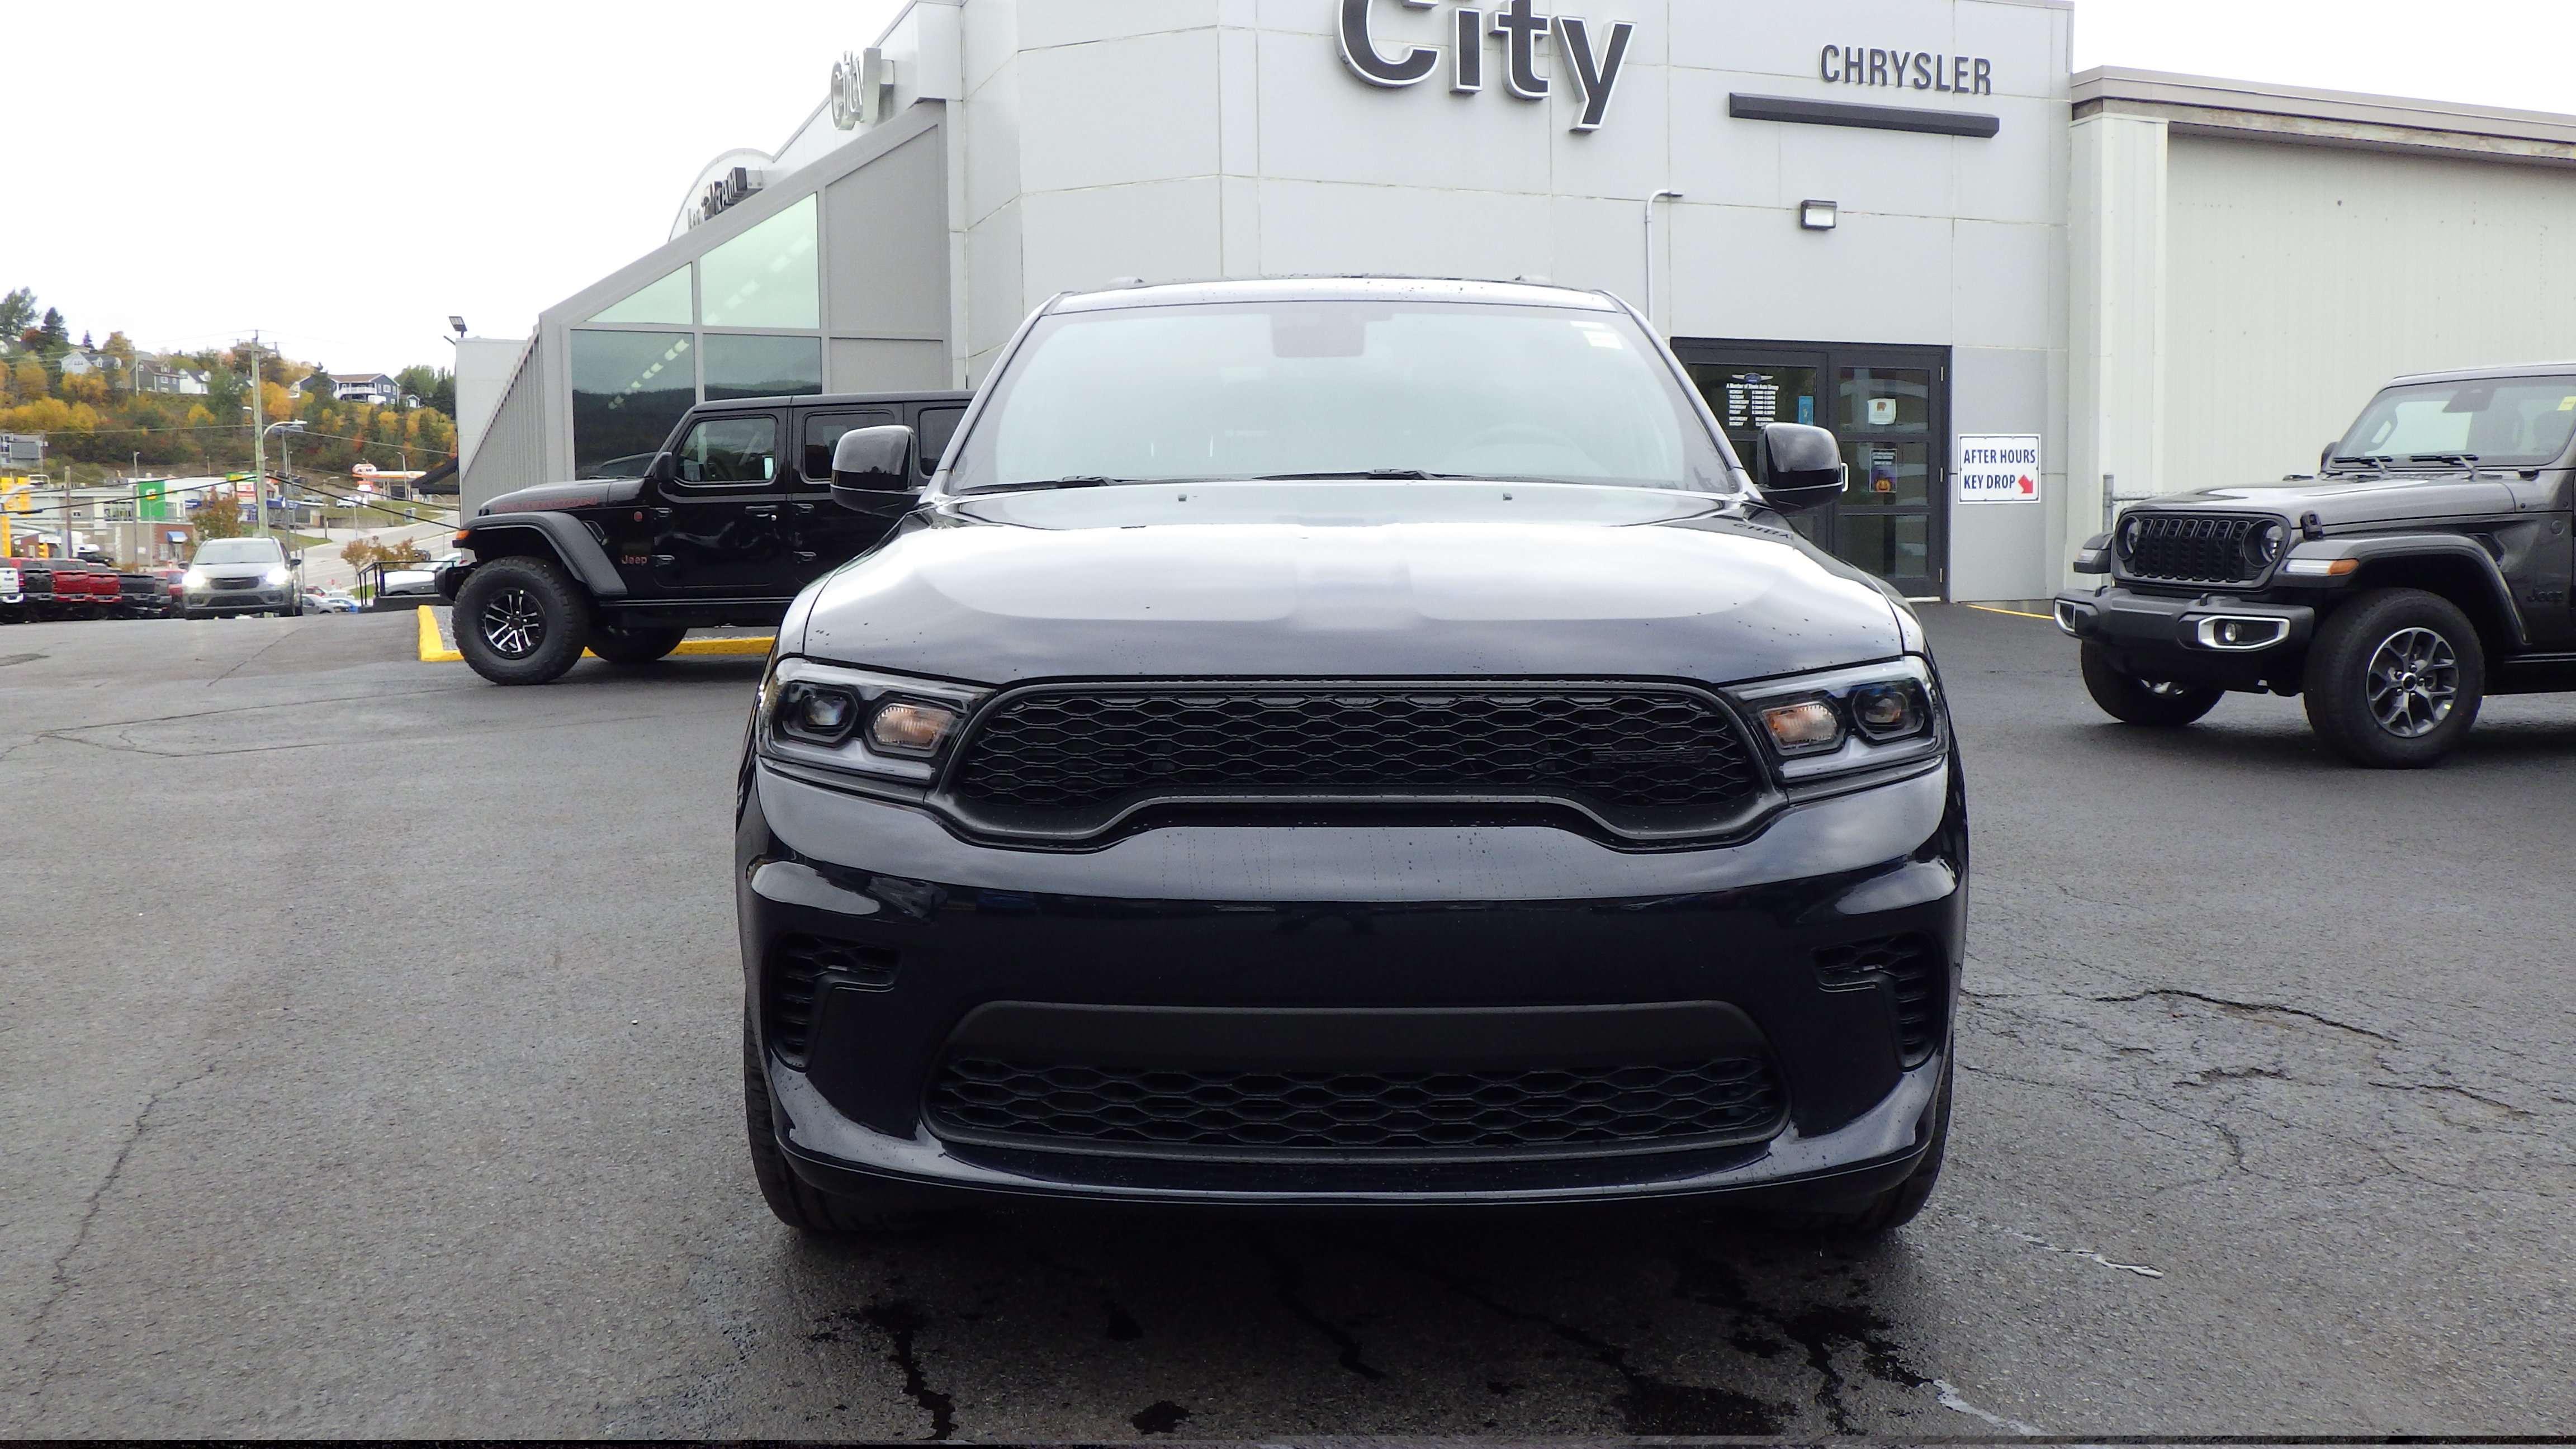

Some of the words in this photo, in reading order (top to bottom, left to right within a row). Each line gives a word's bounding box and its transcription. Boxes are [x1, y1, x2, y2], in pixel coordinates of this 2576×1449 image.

[1335, 0, 1636, 132] City
[1820, 44, 1991, 95] CHRYSLER
[1964, 449, 1997, 463] AFTER
[2000, 449, 2035, 463] HOURS
[1964, 475, 1983, 489] KEY
[1987, 475, 2016, 489] DROP
[622, 555, 647, 565] Jeep
